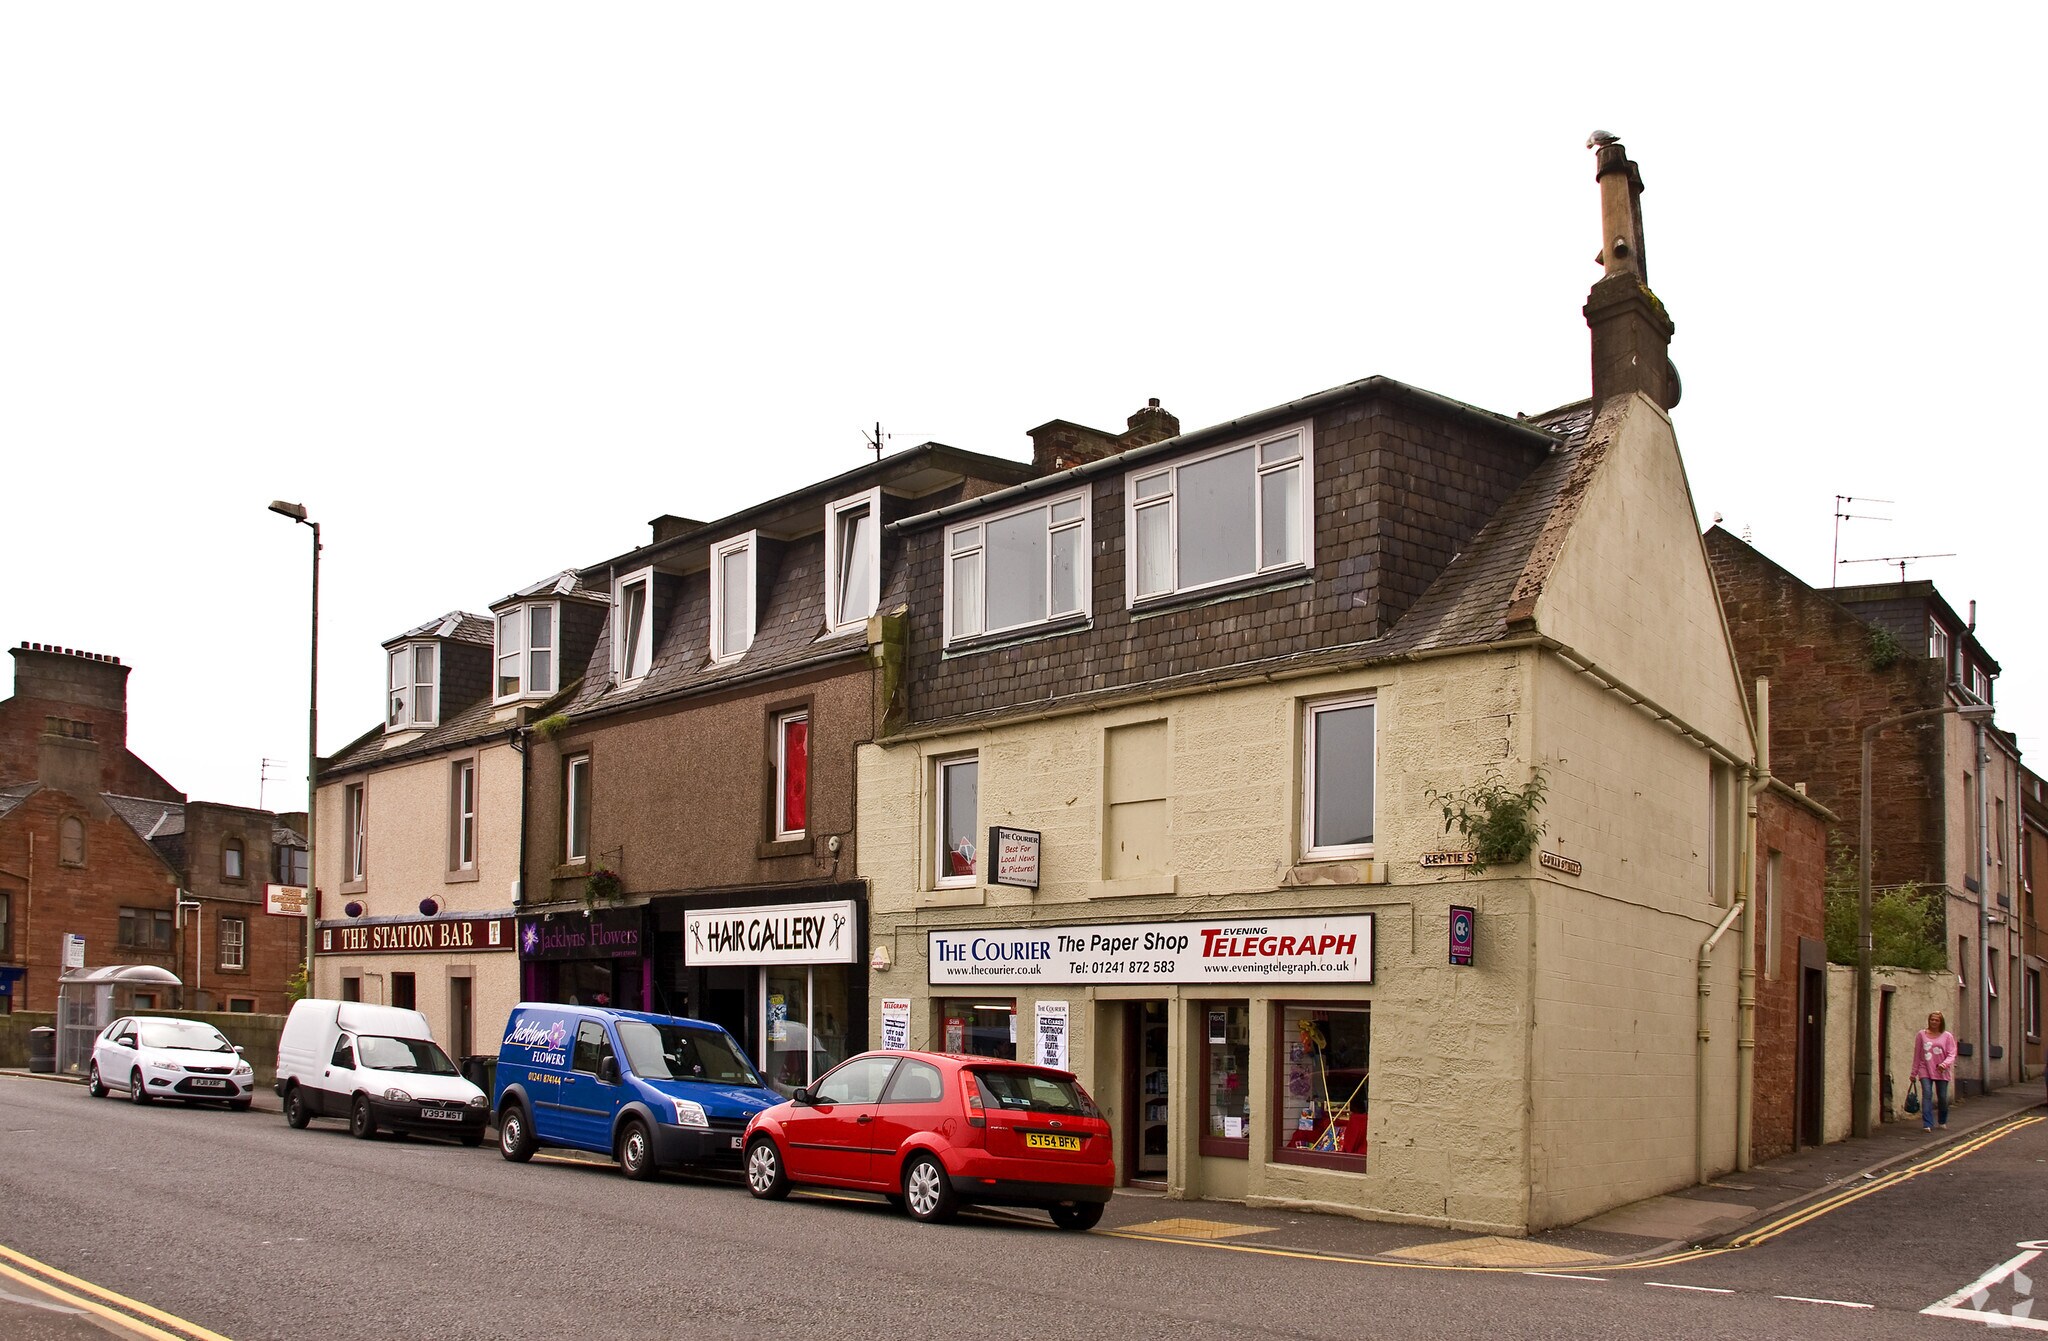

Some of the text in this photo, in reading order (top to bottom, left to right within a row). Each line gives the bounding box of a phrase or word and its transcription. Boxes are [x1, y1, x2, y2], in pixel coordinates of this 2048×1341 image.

[1000, 832, 1038, 844] THE COURIER
[1001, 855, 1017, 863] Local
[1425, 854, 1463, 864] KEPTIE
[342, 922, 473, 949] THE STATION BAR
[708, 915, 825, 953] HAIR GALLERY
[1223, 927, 1268, 935] EVENING
[541, 923, 638, 955] Jacklyns Flowers
[1058, 932, 1188, 955] The Paper Shop
[1201, 929, 1357, 957] TELEGRAPH
[936, 938, 1051, 961] THE COURIER
[947, 964, 1041, 975] www.thecourier.co.uk
[1069, 960, 1175, 973] Tel: 01241 872 583
[1204, 961, 1349, 975] www.eveningtelegraph.co.uk
[884, 1001, 908, 1009] TELEGRAPH
[505, 1019, 550, 1050] Jacklyns
[532, 1051, 565, 1065] FLOWERS
[528, 1072, 542, 1081] 01241
[423, 1109, 462, 1119] V393 MST
[1031, 1134, 1077, 1148] ST54 BFK
